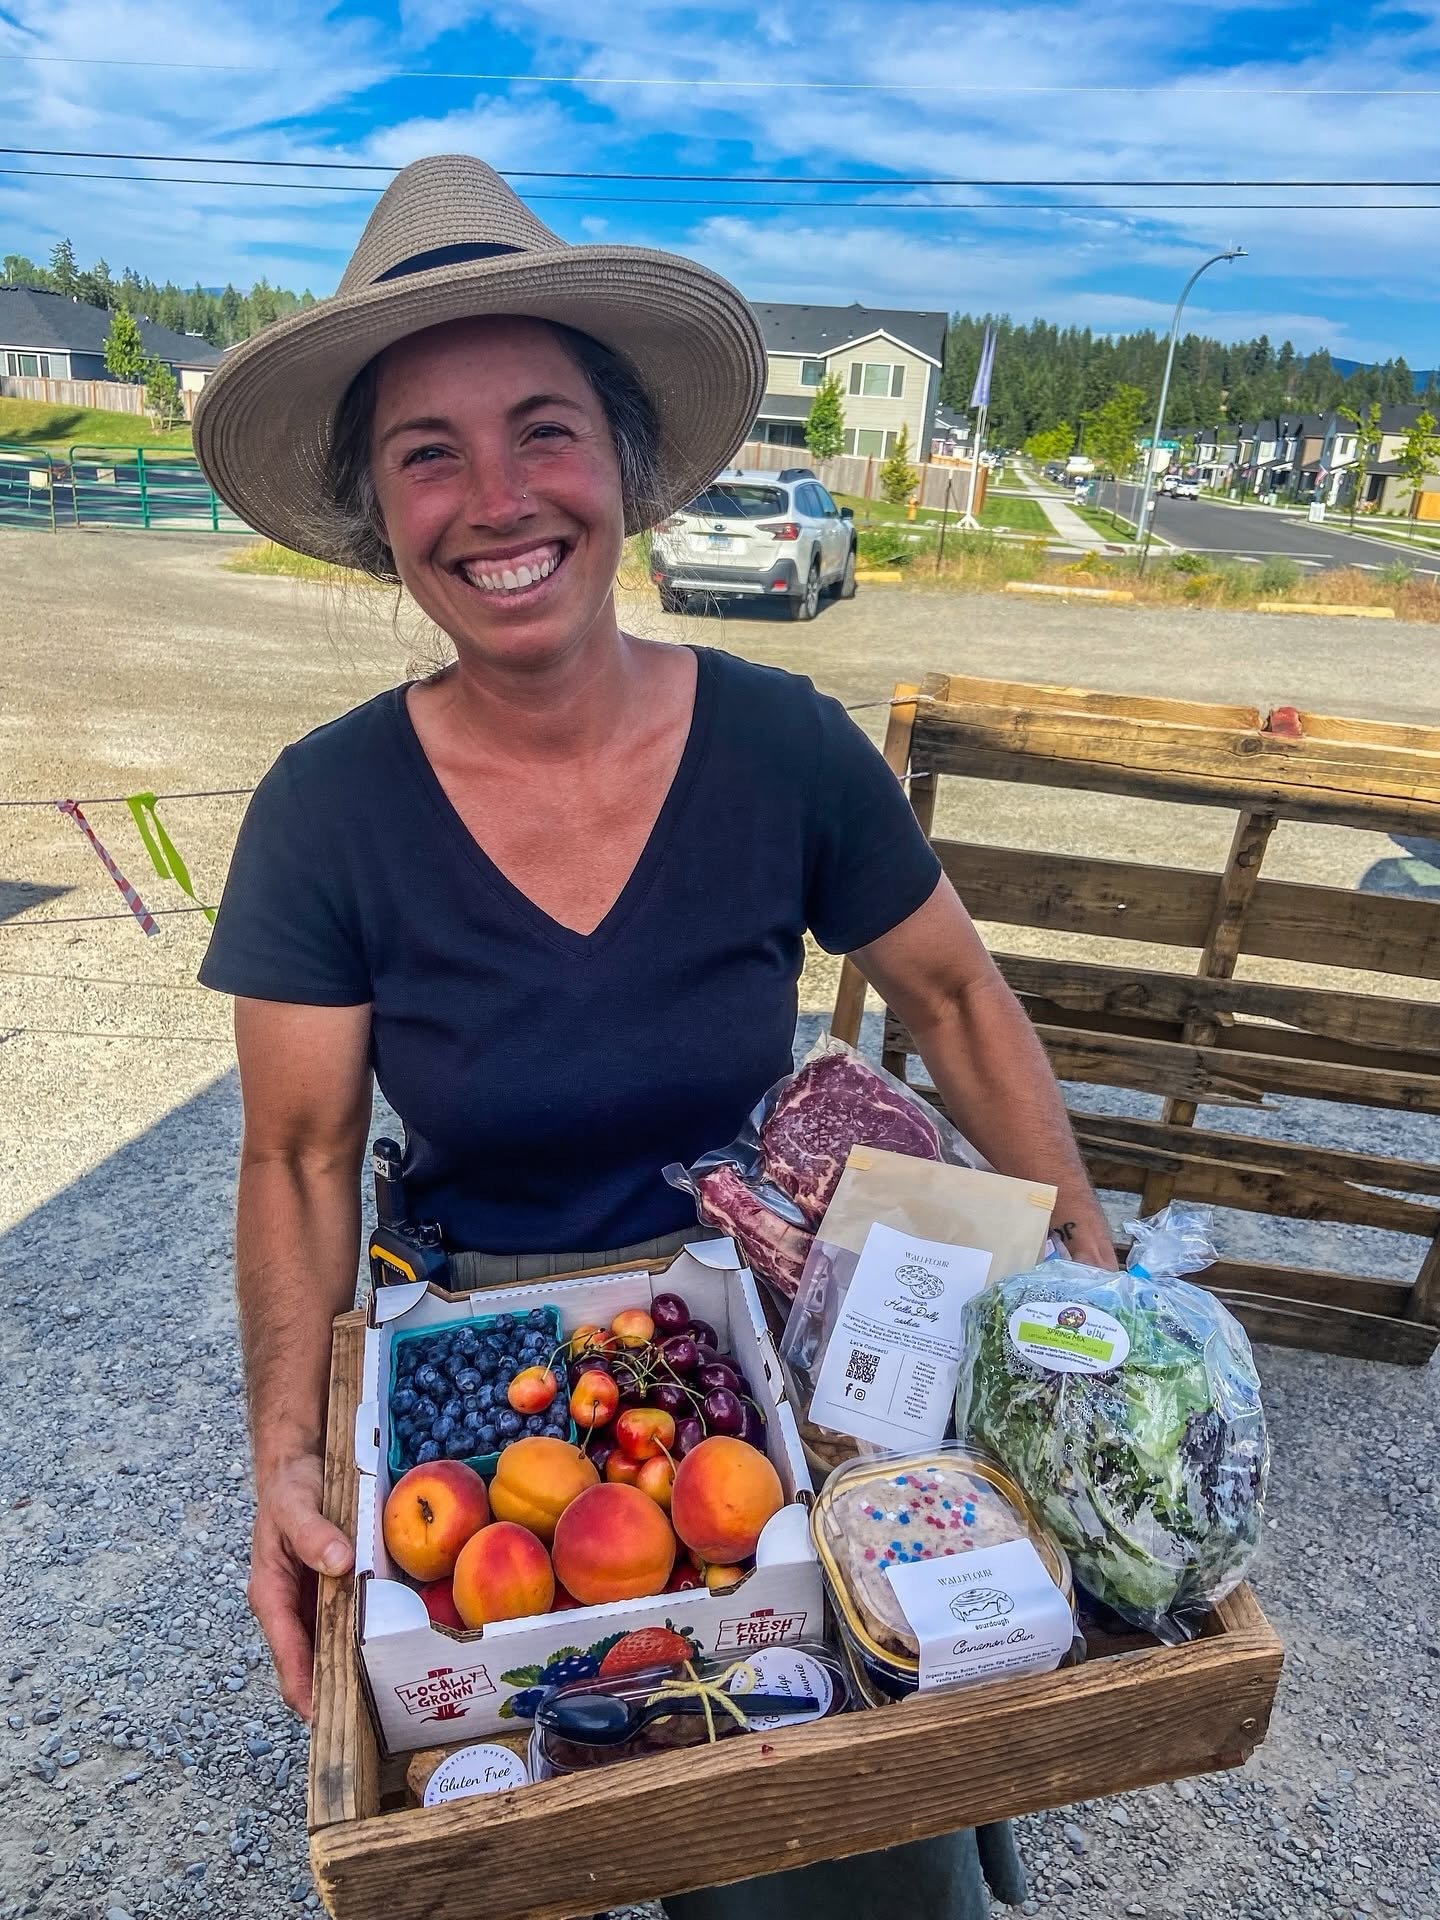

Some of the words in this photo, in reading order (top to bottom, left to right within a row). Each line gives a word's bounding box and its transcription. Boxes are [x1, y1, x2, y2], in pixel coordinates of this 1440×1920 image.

[376, 1160, 387, 1173] 34
[905, 1251, 950, 1268] WALLFLOUR
[900, 1296, 928, 1307] sourdough
[911, 1307, 940, 1322] Dolly
[850, 1339, 863, 1348] Let's
[1046, 1327, 1071, 1340] SPRING
[1071, 1334, 1085, 1343] MIX
[938, 1568, 992, 1586] WALLFLOUR
[736, 1618, 793, 1635] FRESH
[975, 1618, 1010, 1630] sourdough
[737, 1629, 788, 1645] FRUIT
[953, 1639, 1005, 1655] Cinnamon
[1007, 1628, 1036, 1644] Bun
[406, 1672, 476, 1700] LOCALLY
[753, 1666, 768, 1689] Free
[775, 1673, 793, 1696] udge
[794, 1663, 813, 1696] rownie
[418, 1684, 473, 1707] GROWN
[440, 1776, 481, 1793] Gluten
[484, 1766, 511, 1783] Free
